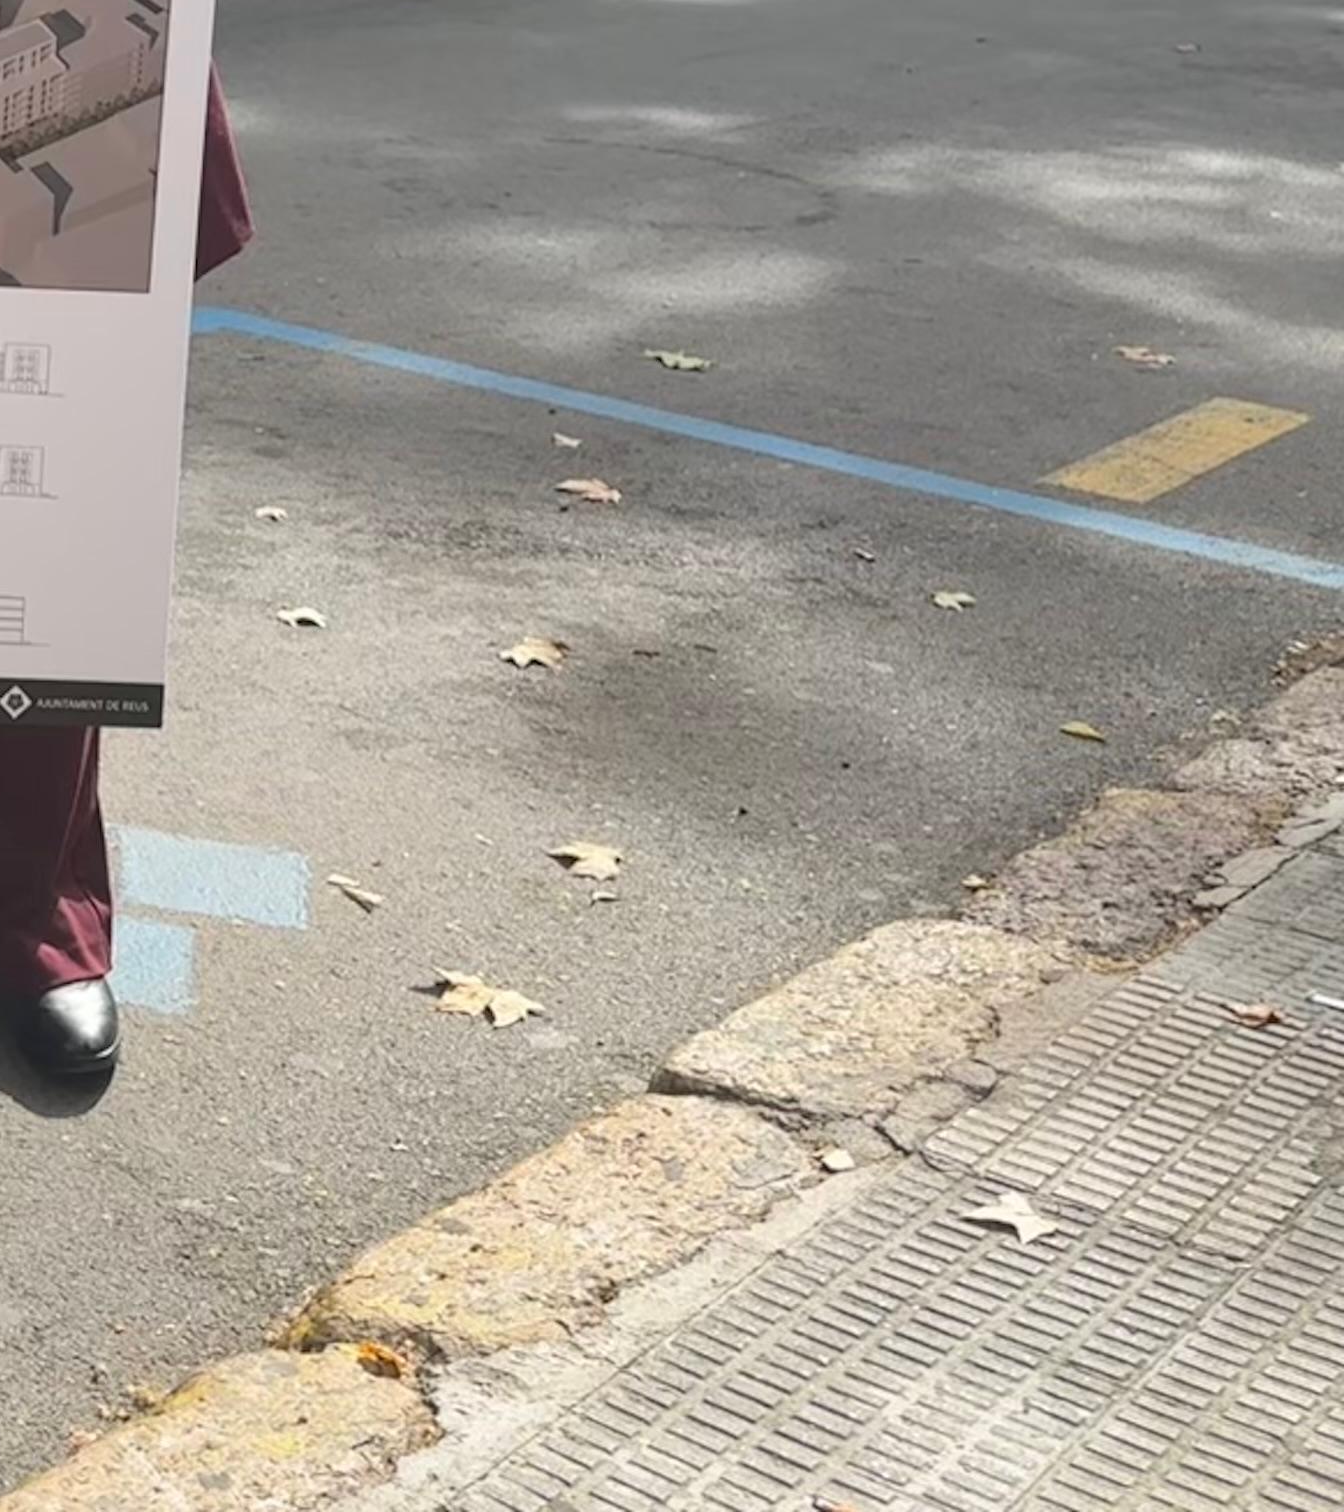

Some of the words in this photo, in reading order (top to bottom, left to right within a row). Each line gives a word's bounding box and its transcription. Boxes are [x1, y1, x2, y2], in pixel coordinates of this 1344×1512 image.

[36, 697, 103, 711] AJUNTAMENT
[105, 700, 120, 711] DE
[122, 701, 149, 713] REUS
